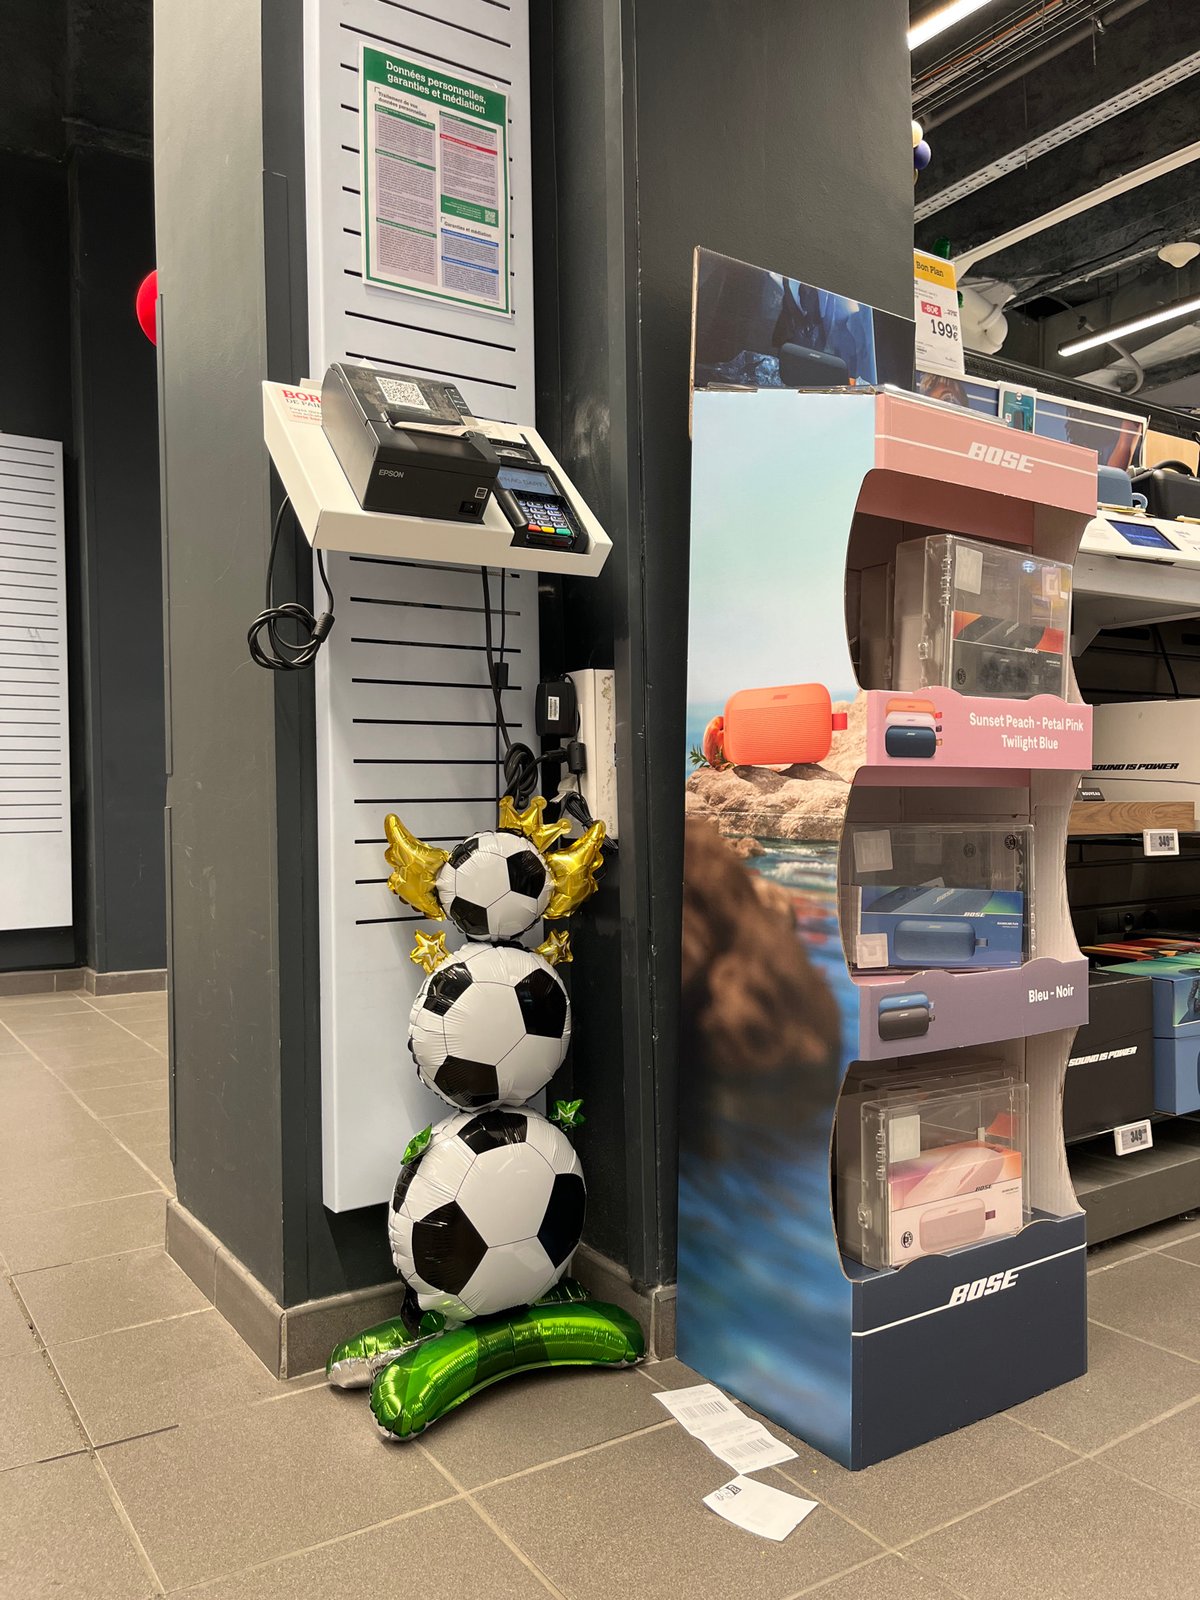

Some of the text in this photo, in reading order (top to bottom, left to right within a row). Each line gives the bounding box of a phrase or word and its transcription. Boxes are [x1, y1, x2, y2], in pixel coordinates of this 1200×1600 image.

[386, 60, 487, 104] Données personnelles,
[387, 74, 486, 114] garanties et médiation
[916, 260, 944, 278] Bon Plan
[282, 389, 321, 404] BOR
[968, 441, 1034, 474] BOSE
[379, 469, 404, 478] EPSON
[969, 712, 1004, 728] Sunset
[1006, 714, 1035, 729] Peach
[1042, 716, 1064, 730] Petal
[1066, 718, 1084, 732] Pink
[1002, 734, 1058, 751] Twilight Blue
[1028, 988, 1048, 1003] Bleu
[1056, 984, 1074, 998] Noir
[1068, 1046, 1138, 1068] SOUND IS POWER
[948, 1269, 1019, 1307] BOSE
